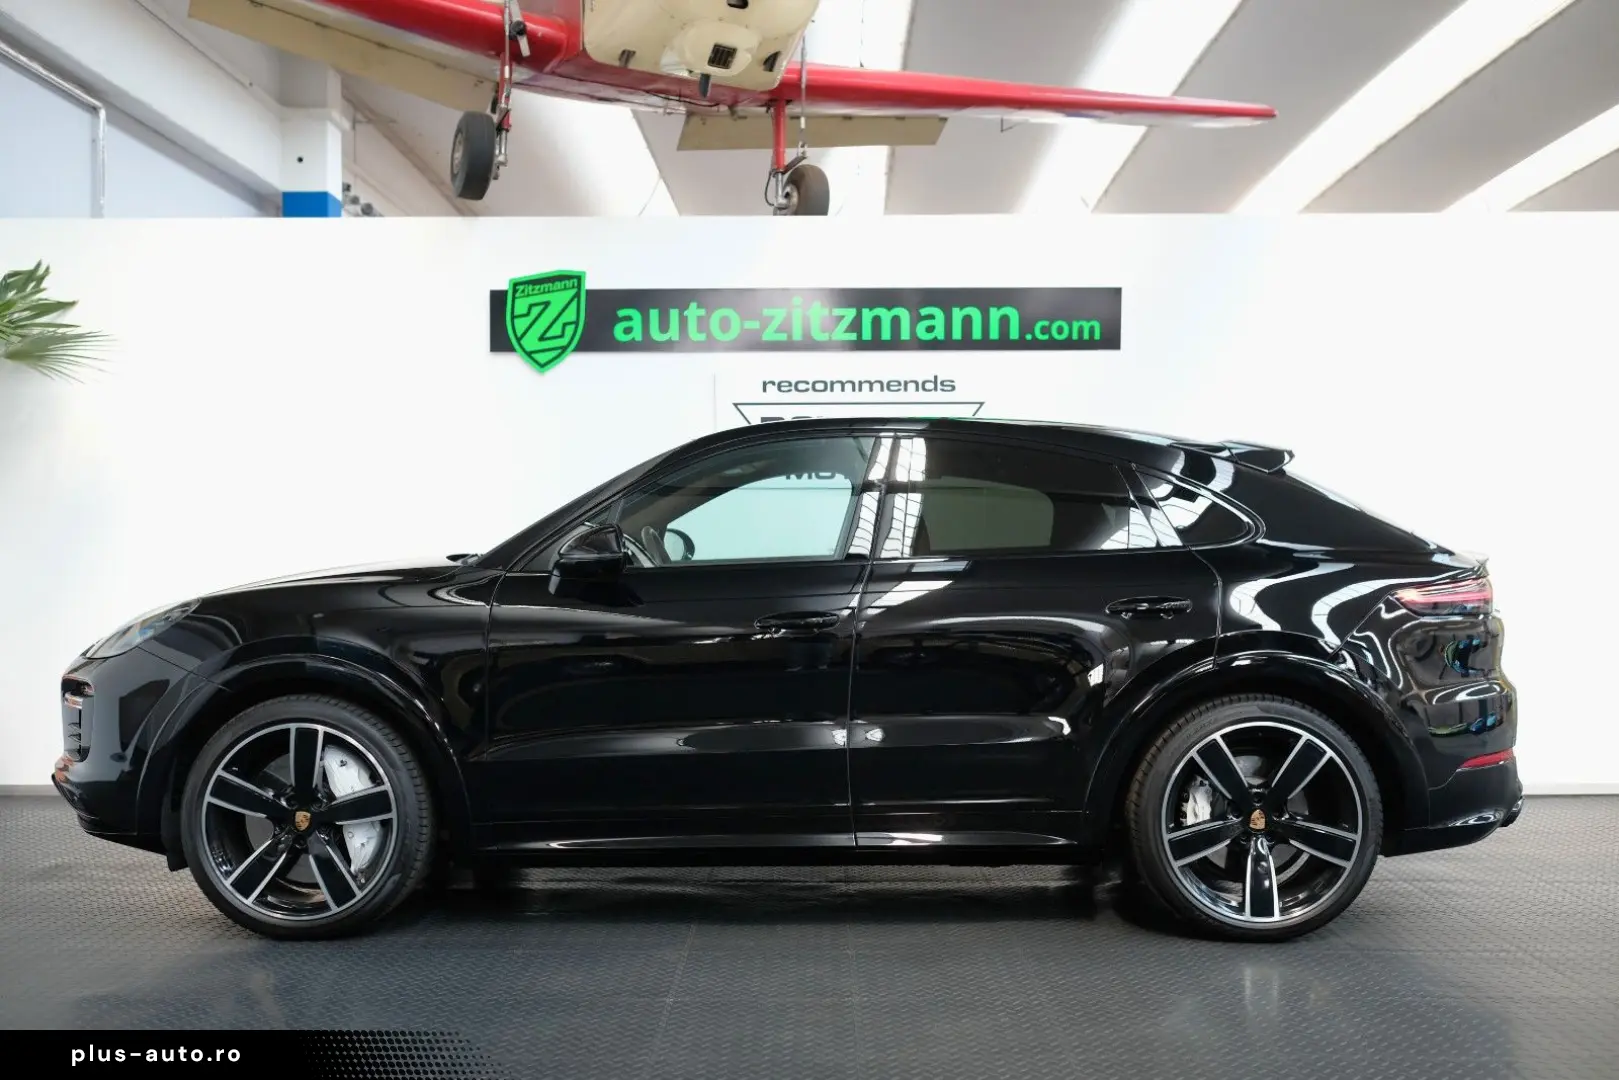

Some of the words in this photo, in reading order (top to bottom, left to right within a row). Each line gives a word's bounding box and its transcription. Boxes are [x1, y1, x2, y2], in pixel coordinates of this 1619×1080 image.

[514, 279, 578, 297] Zitzmann
[613, 295, 1102, 342] auto-zitzmann.com
[761, 374, 957, 394] recommends
